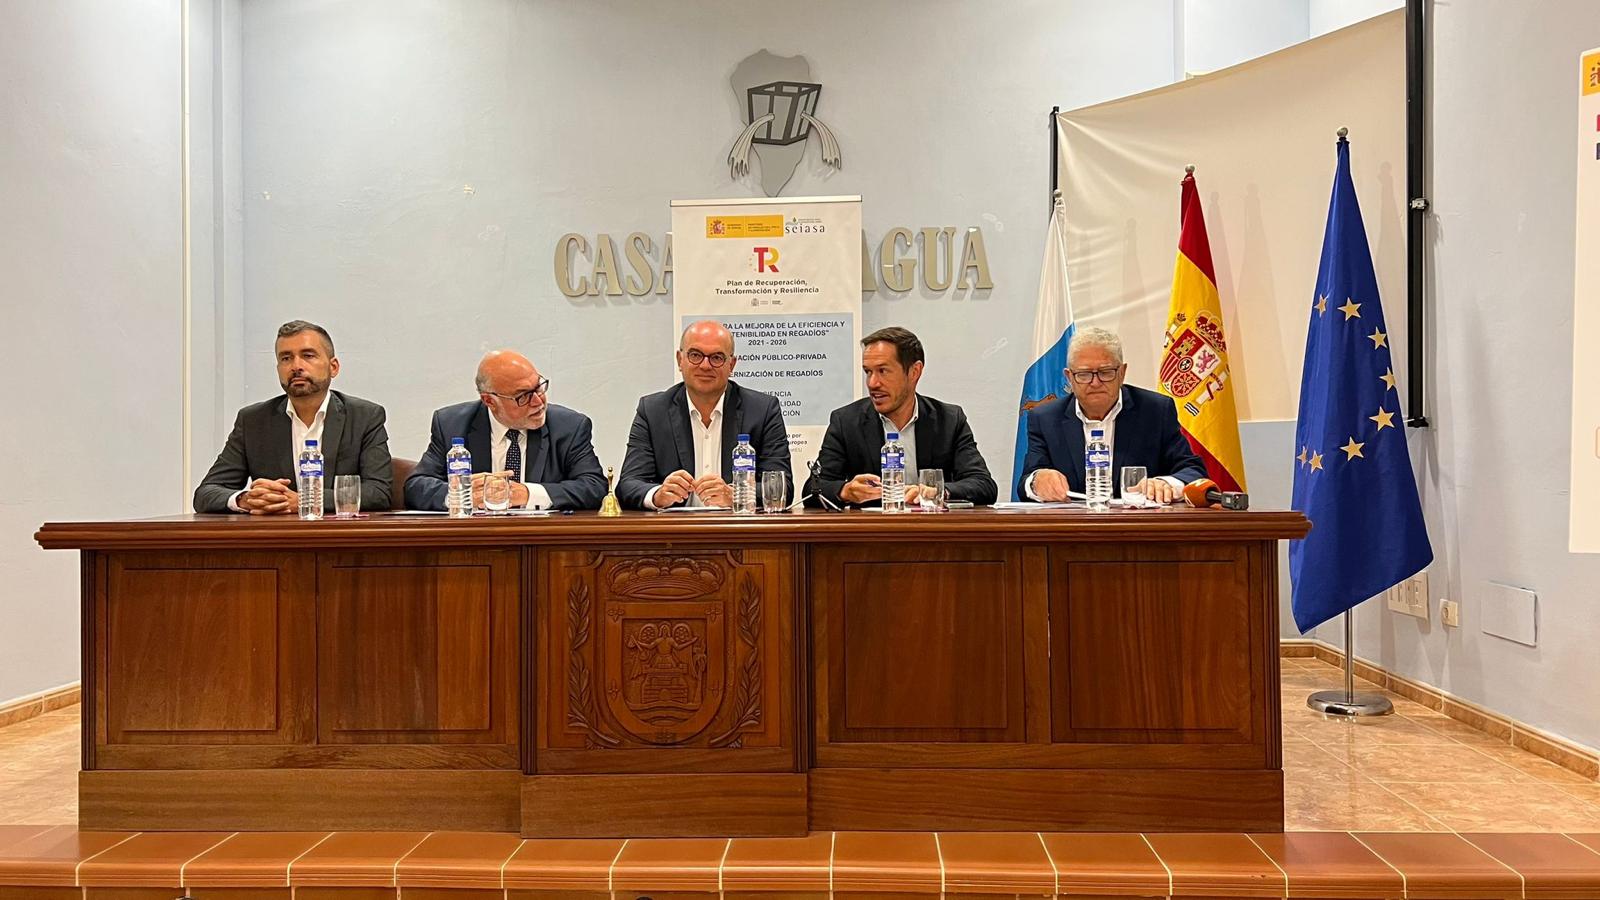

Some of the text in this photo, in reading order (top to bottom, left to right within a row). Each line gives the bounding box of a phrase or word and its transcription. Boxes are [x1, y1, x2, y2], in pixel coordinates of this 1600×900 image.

[744, 279, 754, 287] de
[755, 279, 808, 287] Recuperación,
[715, 286, 820, 295] Transformación y Resiliencia
[745, 322, 775, 330] MEJORA
[762, 353, 828, 361] PÚBLICO-PRIVADA
[728, 370, 774, 378] ERNIZACIÓN
[786, 369, 824, 377] REGADÍOS
